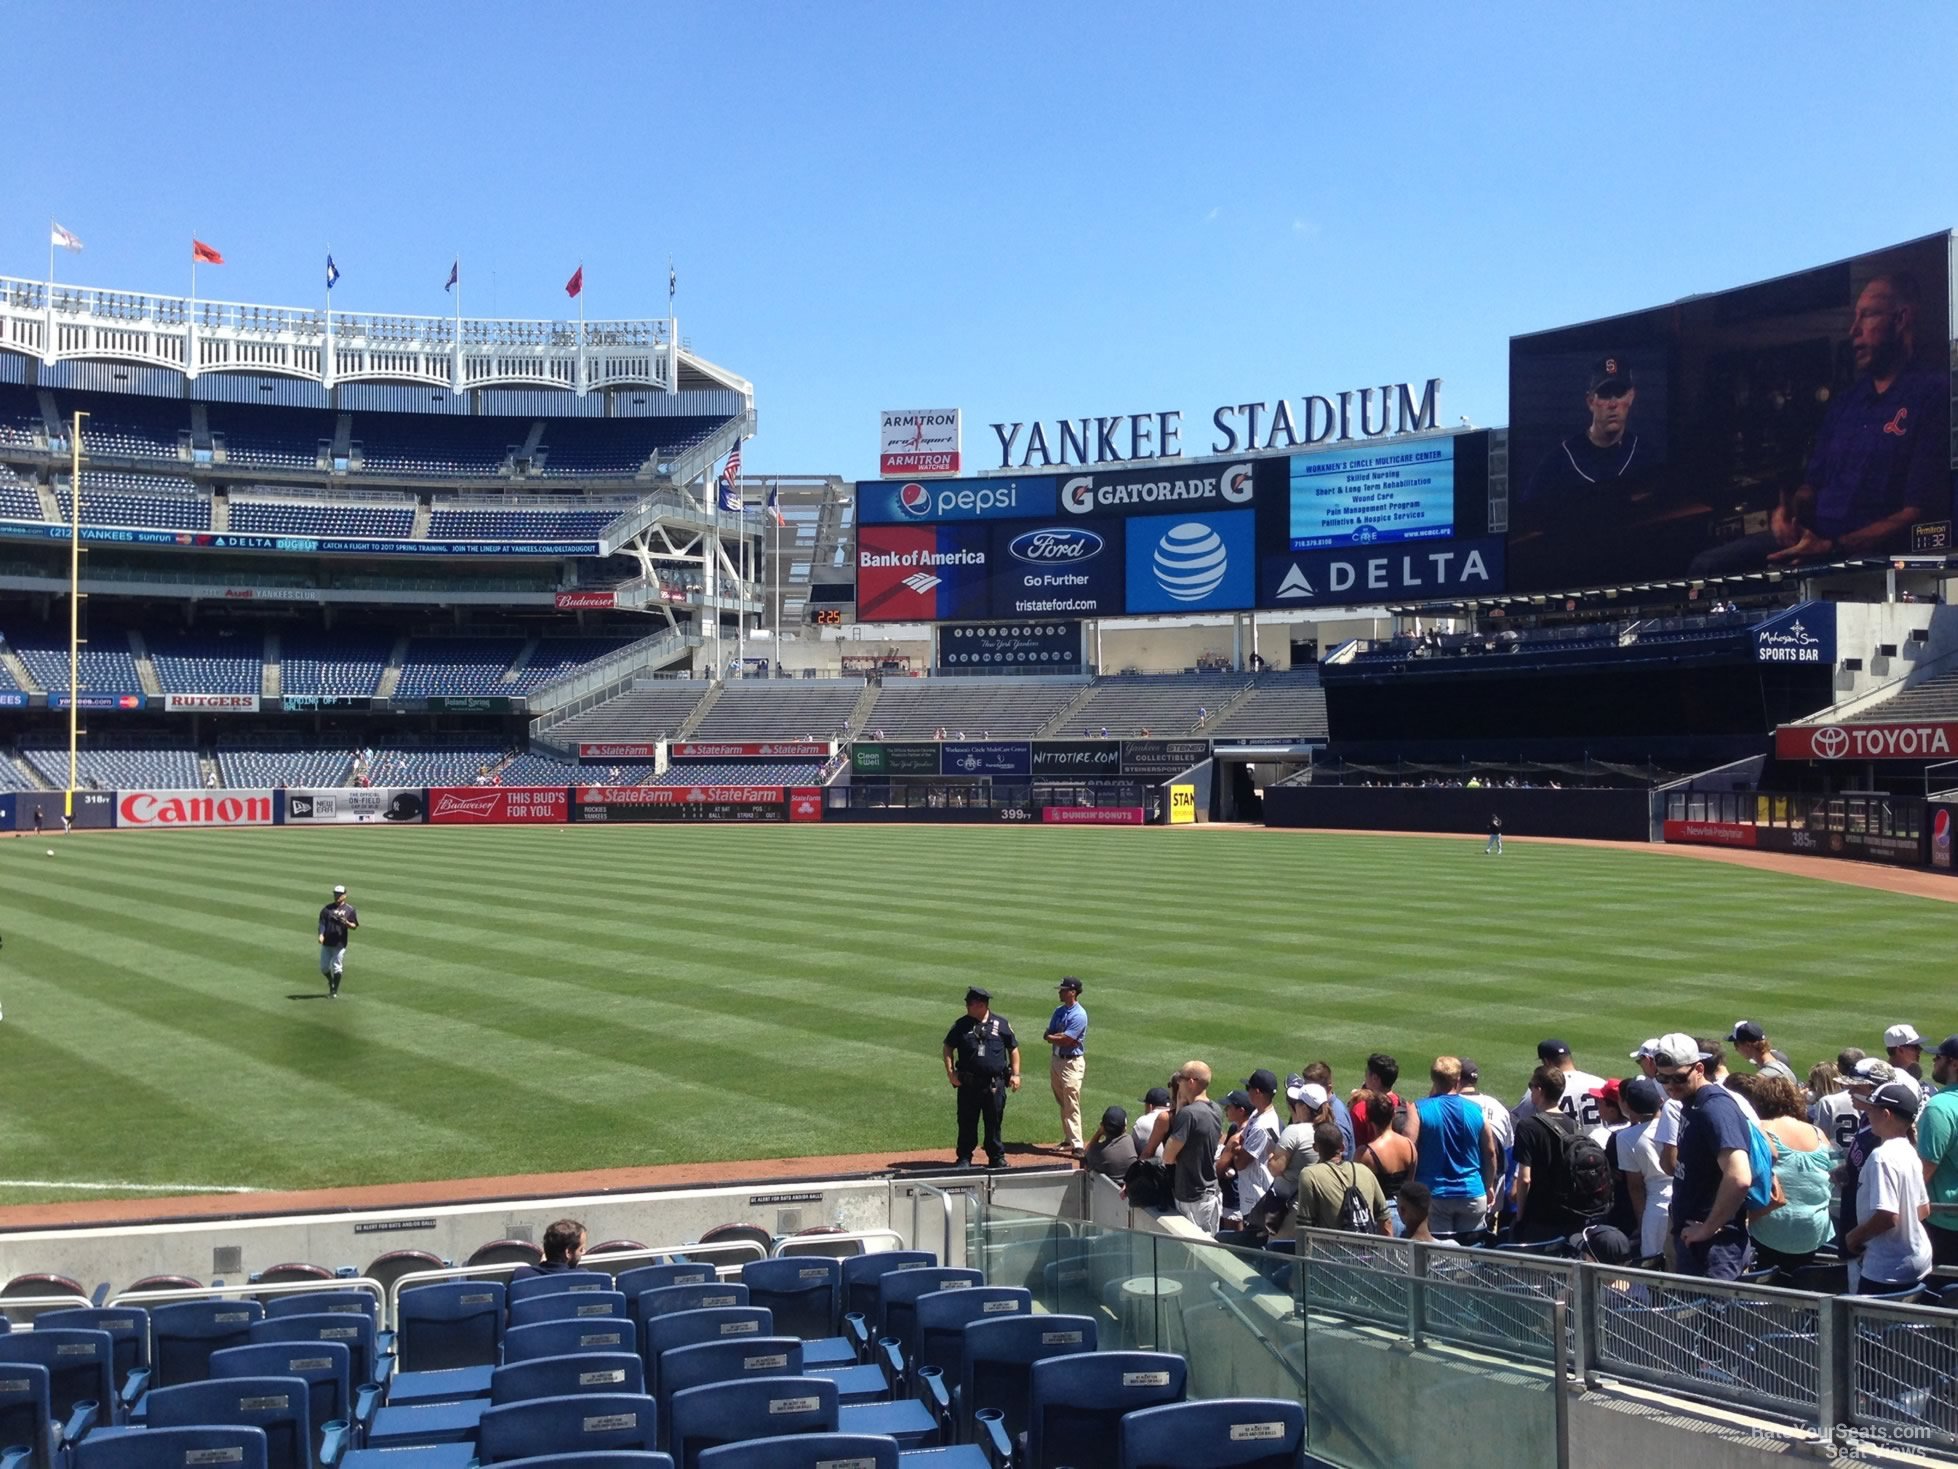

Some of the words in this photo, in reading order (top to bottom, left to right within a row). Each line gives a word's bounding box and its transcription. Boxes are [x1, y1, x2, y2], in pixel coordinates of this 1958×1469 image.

[883, 415, 955, 427] ARMITRON
[989, 410, 1183, 468] YANKEE
[1212, 378, 1443, 454] STADIUM
[887, 455, 951, 466] ARMITRON
[1306, 462, 1347, 473] WORKMEN'S
[1349, 459, 1373, 469] CIRCLE
[1375, 454, 1414, 466] MULTICARE
[1415, 450, 1442, 461] CENTER
[1346, 474, 1370, 483] Skilled
[1372, 470, 1400, 481] Nursing
[1098, 479, 1216, 505] GATORADE
[1315, 487, 1336, 496] Short
[1345, 485, 1361, 495] Long
[1364, 483, 1381, 492] Term
[1383, 478, 1431, 490] Rehabilitation
[938, 484, 1017, 515] pepsi
[1352, 494, 1375, 503] Wound
[1376, 492, 1394, 501] Care
[1326, 508, 1342, 516] Pain
[1343, 503, 1387, 516] Management
[1389, 500, 1420, 511] Program
[1321, 517, 1355, 527] Palliative
[1364, 513, 1391, 525] Hospice
[1393, 510, 1425, 520] Services
[50, 527, 73, 538] (212
[81, 530, 133, 541] YANKEES
[139, 534, 171, 542] sunrun
[1916, 525, 1946, 536] Armitron
[229, 538, 272, 547] DELTA
[1027, 531, 1085, 559] Ford
[1917, 534, 1945, 548] 11:32
[860, 551, 900, 567] Bank
[902, 550, 919, 566] of
[920, 549, 985, 566] America
[1329, 550, 1489, 591] DELTA
[1024, 575, 1041, 586] Go
[1044, 573, 1089, 586] Further
[225, 588, 253, 597] Audi
[256, 590, 293, 598] YANKEES
[557, 595, 613, 607] Budweiser
[1016, 598, 1096, 612] tristateford.com
[1759, 631, 1798, 645] Mohegan
[1800, 633, 1819, 644] Sun
[1759, 648, 1797, 661] SPORTS
[1799, 648, 1818, 661] BAR
[171, 696, 253, 706] RUTGERS
[1853, 728, 1950, 754] TOYOTA
[1033, 751, 1118, 764] NITTOTIRE.COM
[439, 797, 493, 810] Budweiser
[507, 792, 532, 804] THIS
[534, 792, 565, 804] BUD'S
[120, 793, 270, 823] Canon
[507, 805, 527, 816] FOR
[530, 805, 553, 816] YOU.
[1559, 1095, 1600, 1126] 42
